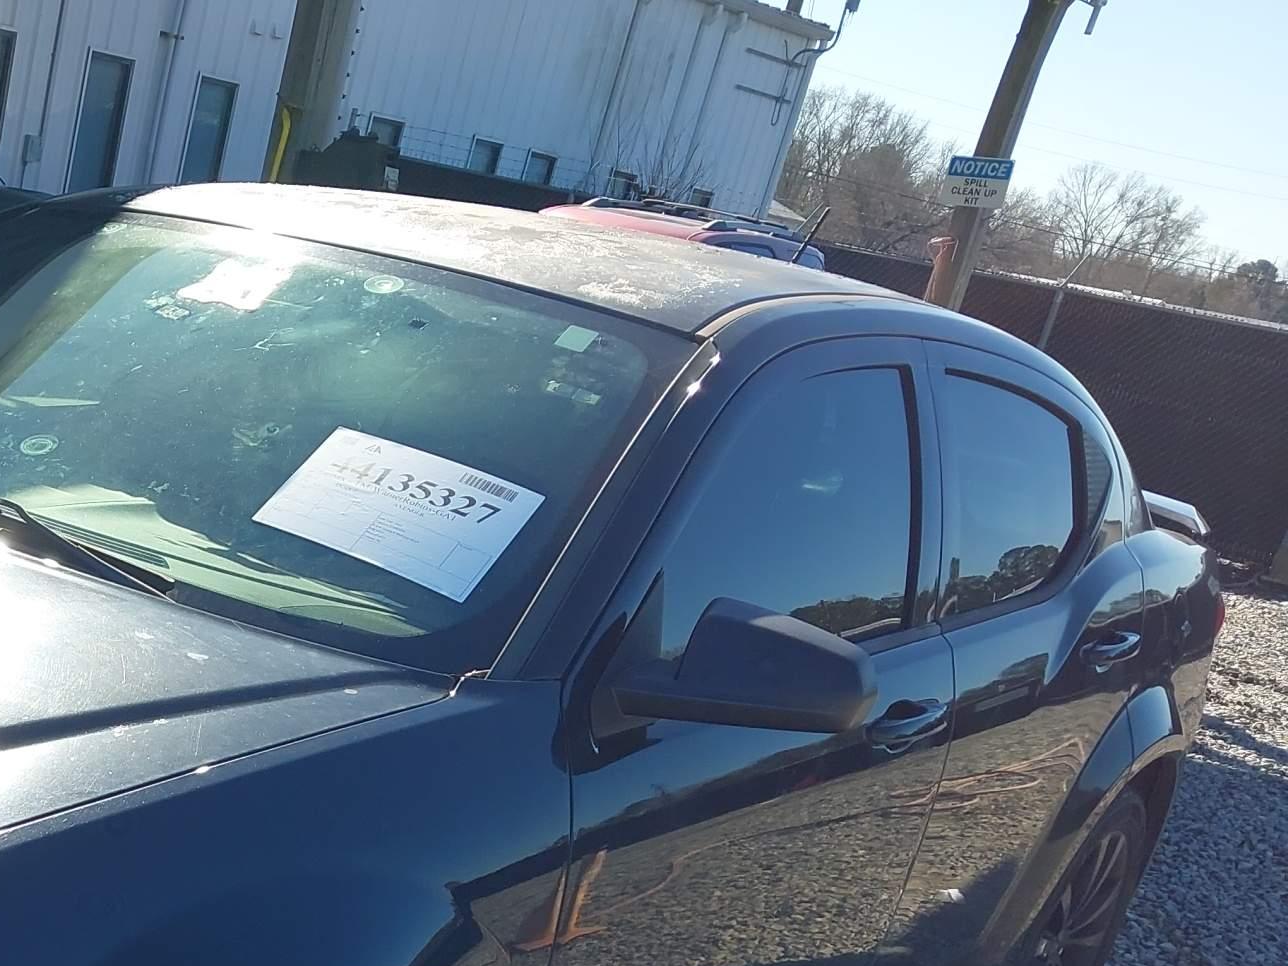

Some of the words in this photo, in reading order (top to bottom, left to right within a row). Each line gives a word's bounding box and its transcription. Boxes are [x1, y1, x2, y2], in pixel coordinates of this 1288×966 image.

[950, 160, 1010, 177] NOTICE
[963, 178, 989, 188] SPILL
[951, 186, 980, 196] CLEAN
[984, 189, 997, 198] UP
[963, 197, 980, 206] KIT
[330, 456, 502, 524] 44135327
